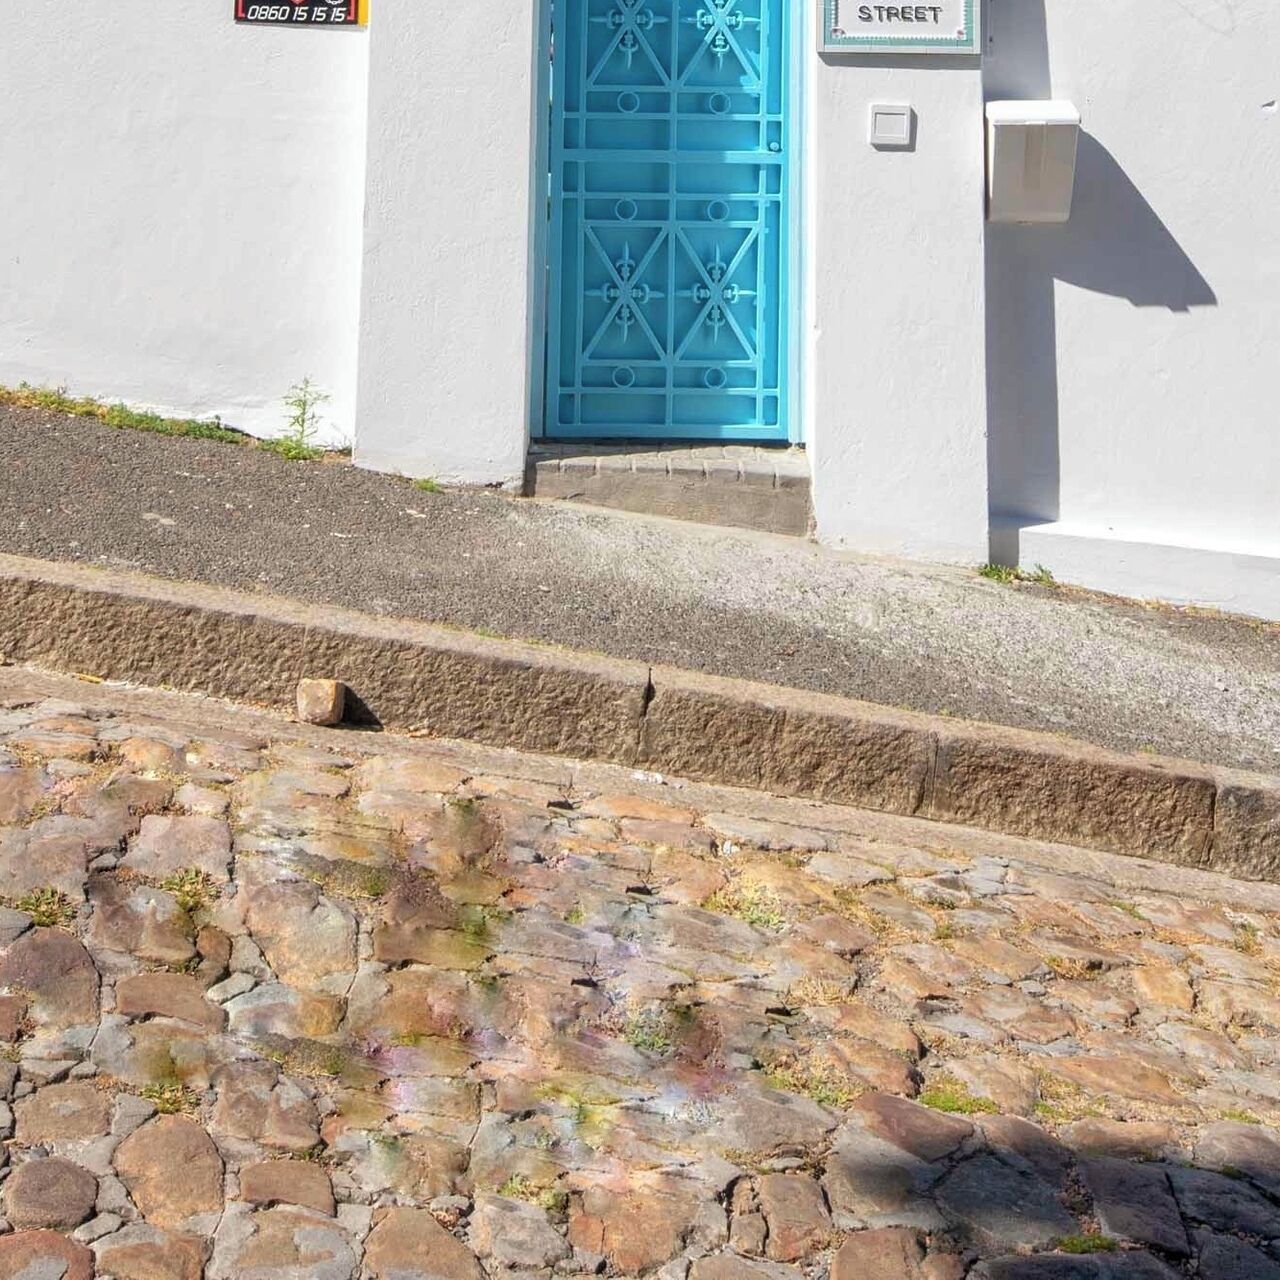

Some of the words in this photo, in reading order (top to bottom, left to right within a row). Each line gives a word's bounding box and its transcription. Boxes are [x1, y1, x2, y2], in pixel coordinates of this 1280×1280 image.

[247, 5, 290, 21] 0860
[291, 6, 308, 21] 15
[310, 7, 327, 21] 15
[329, 7, 347, 22] 15
[857, 5, 942, 24] STREET
